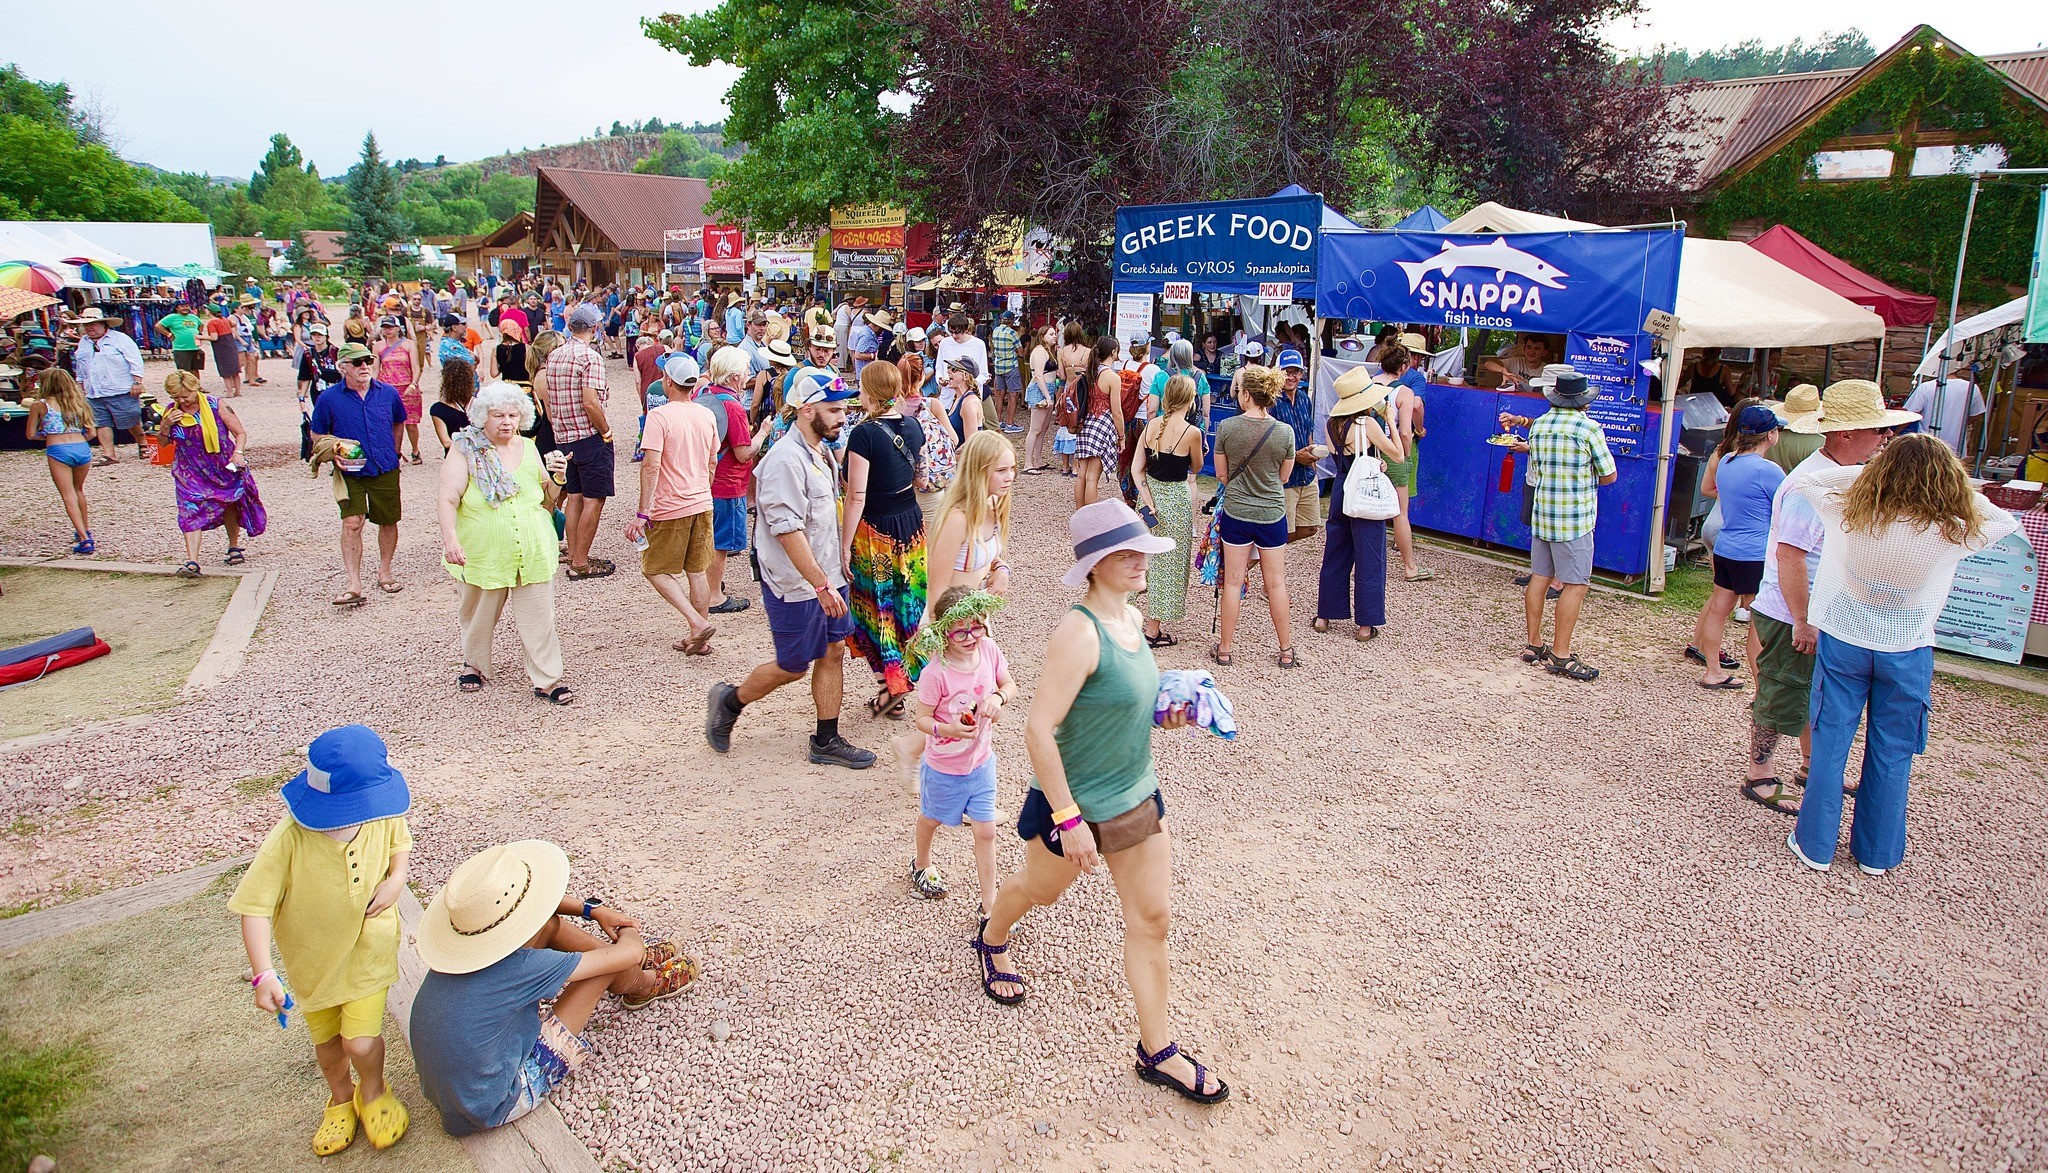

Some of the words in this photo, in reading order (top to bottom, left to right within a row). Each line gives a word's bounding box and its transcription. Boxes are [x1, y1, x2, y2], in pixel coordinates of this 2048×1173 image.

[845, 207, 887, 219] SQUEEZED
[833, 218, 862, 226] LEMONADE
[842, 231, 866, 246] CORN
[866, 230, 892, 247] DOGS
[1121, 213, 1216, 255] GREEK
[1229, 213, 1313, 251] FOOD
[1120, 262, 1148, 274] Greek
[1149, 262, 1178, 274] Salads
[1186, 261, 1235, 276] GYROS
[1245, 262, 1310, 276] Spanakopita
[1165, 285, 1190, 300] ORDER
[1260, 284, 1279, 297] PICK
[1280, 284, 1292, 297] UP
[1419, 281, 1543, 315] SNAPPA
[1445, 311, 1470, 325] fish
[1474, 313, 1513, 328] tacos
[1661, 314, 1671, 322] NO
[1652, 319, 1670, 331] GUAC
[1591, 344, 1625, 353] SNAPPA
[1599, 423, 1631, 431] SADILLA
[1605, 436, 1637, 445] CHOWDA
[1953, 586, 1983, 596] Dessert
[1985, 591, 2015, 602] Crepes
[1951, 605, 1971, 613] banana
[1964, 620, 1987, 628] whipped
